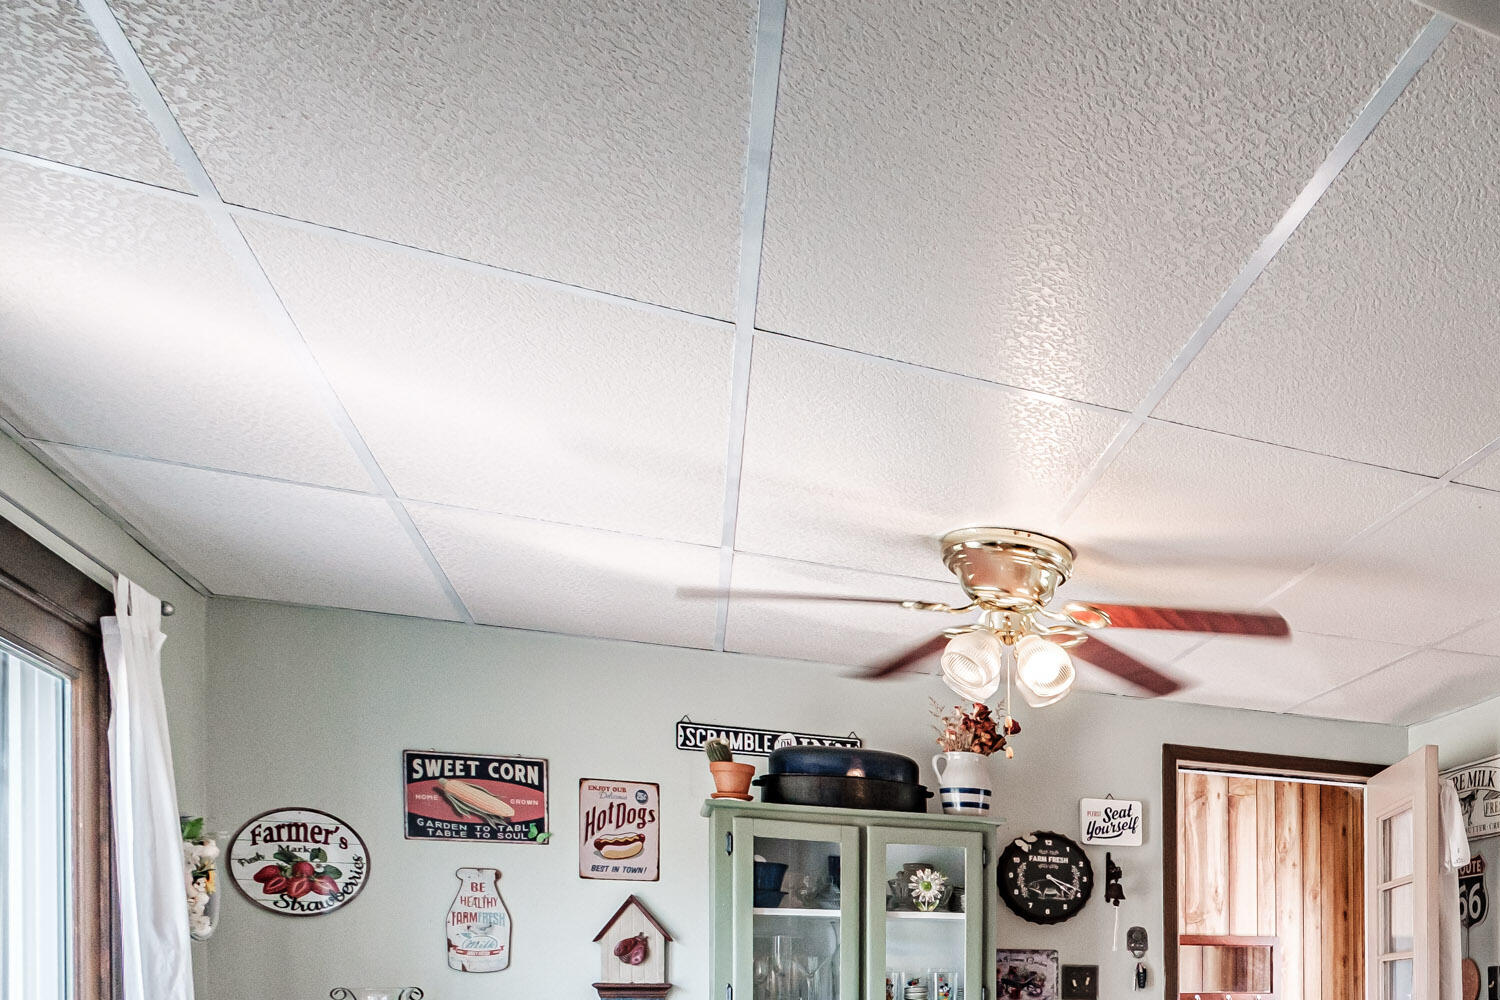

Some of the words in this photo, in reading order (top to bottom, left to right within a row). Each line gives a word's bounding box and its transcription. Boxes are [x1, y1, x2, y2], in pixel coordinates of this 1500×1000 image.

[412, 758, 480, 779] SWEET
[488, 762, 539, 786] CORN
[1467, 769, 1497, 788] MILK
[509, 798, 539, 806] GROWN
[1102, 803, 1133, 824] Seat
[416, 818, 468, 831] GARDEN
[499, 823, 532, 833] TABL
[426, 828, 468, 838] TABLE
[497, 832, 529, 840] SOUL
[1086, 815, 1140, 842] Yourself
[250, 822, 349, 850] Farmer's
[1048, 856, 1069, 864] FRESH
[591, 864, 610, 873] BEST
[612, 865, 620, 873] IN
[622, 865, 648, 874] TOWN!
[273, 853, 364, 912] Strawberries
[470, 881, 486, 893] BE
[460, 896, 498, 909] HEALTHY
[1459, 882, 1482, 920] 66
